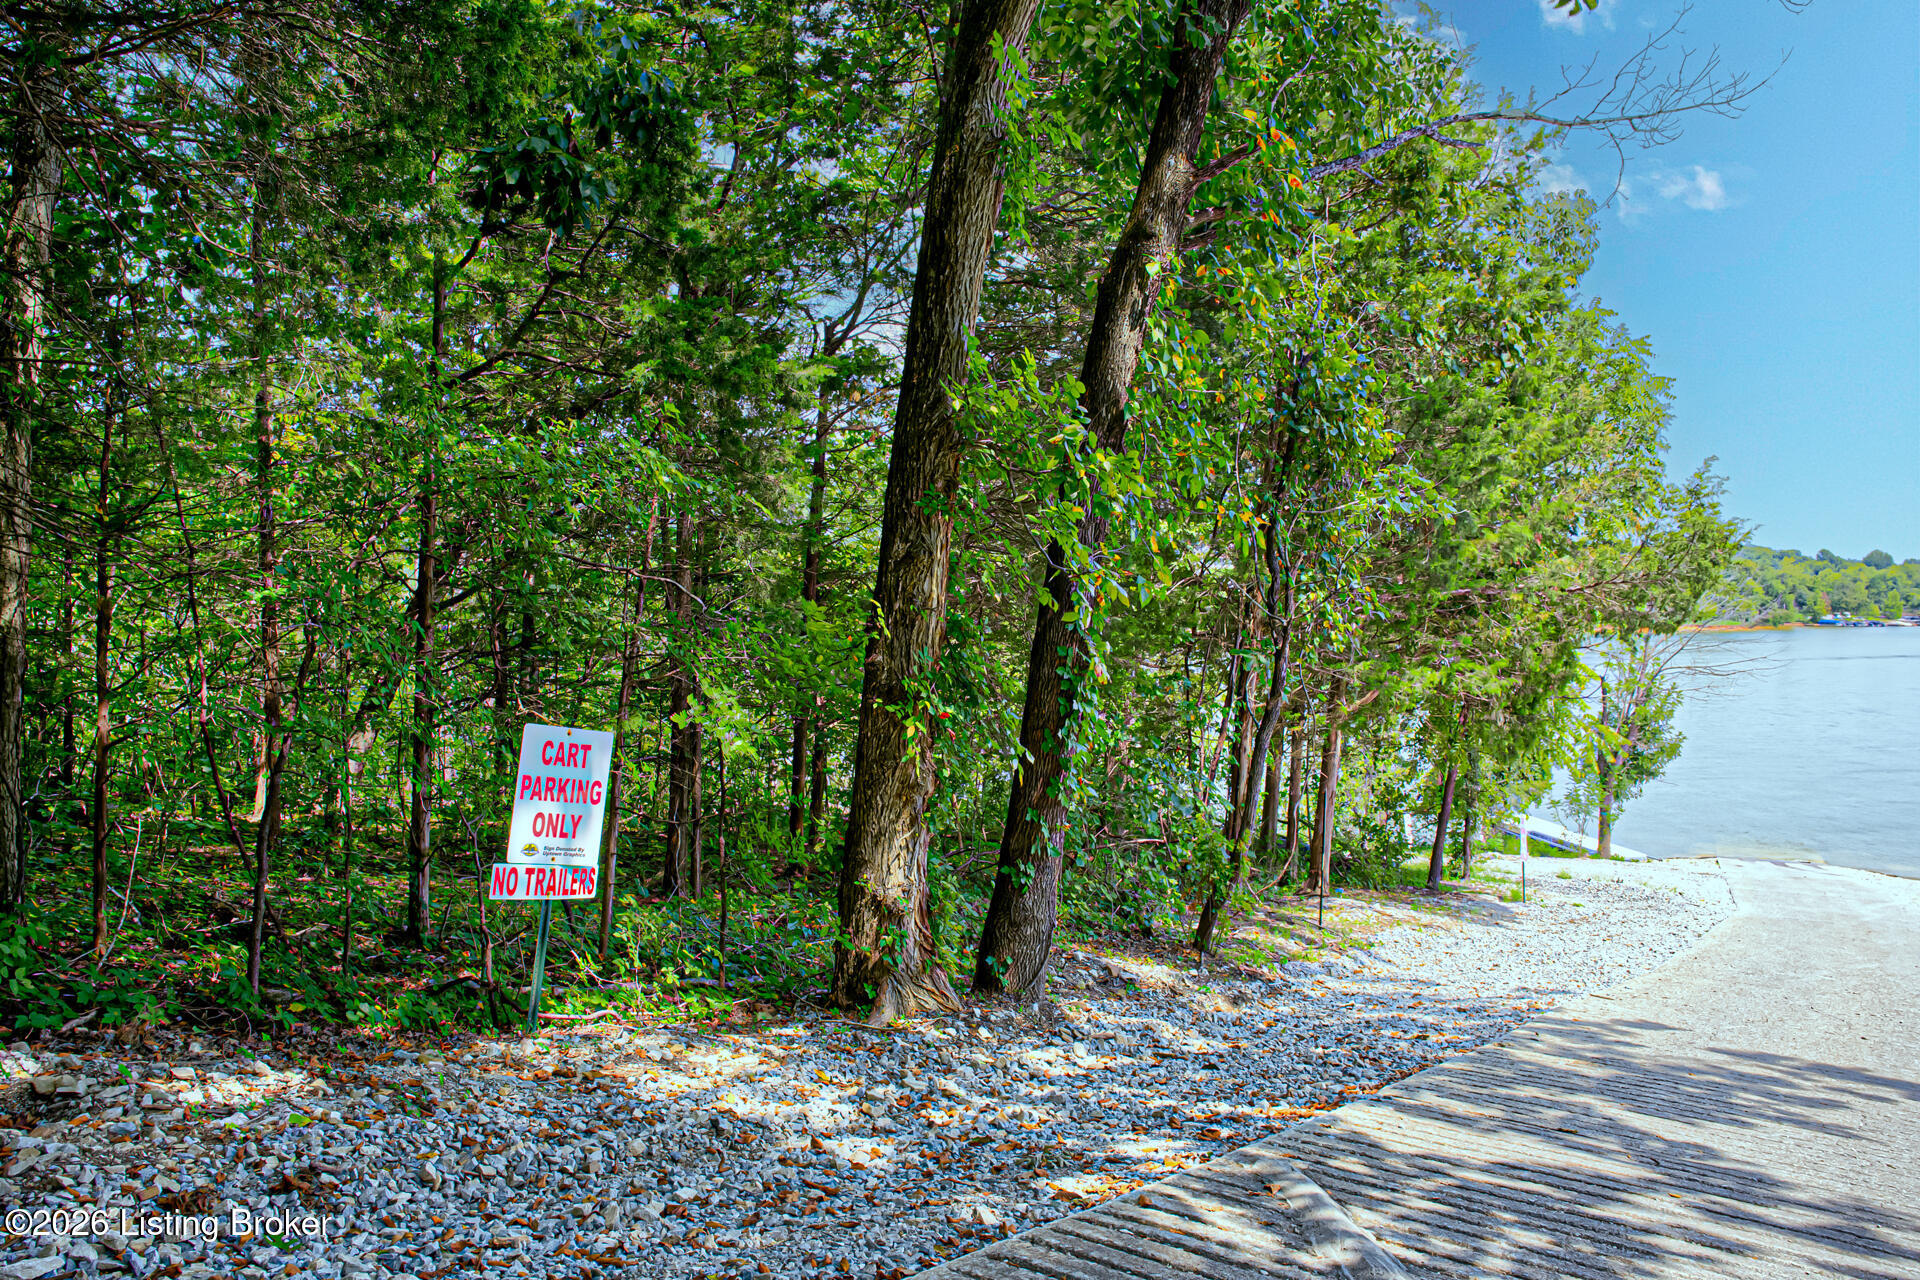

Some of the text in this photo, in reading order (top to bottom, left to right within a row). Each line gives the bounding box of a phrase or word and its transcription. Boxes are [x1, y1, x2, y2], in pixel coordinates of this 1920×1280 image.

[542, 740, 592, 768] CART
[520, 775, 602, 805] PARKING
[532, 812, 582, 839] ONLY
[492, 867, 596, 896] NO TRAILERS
